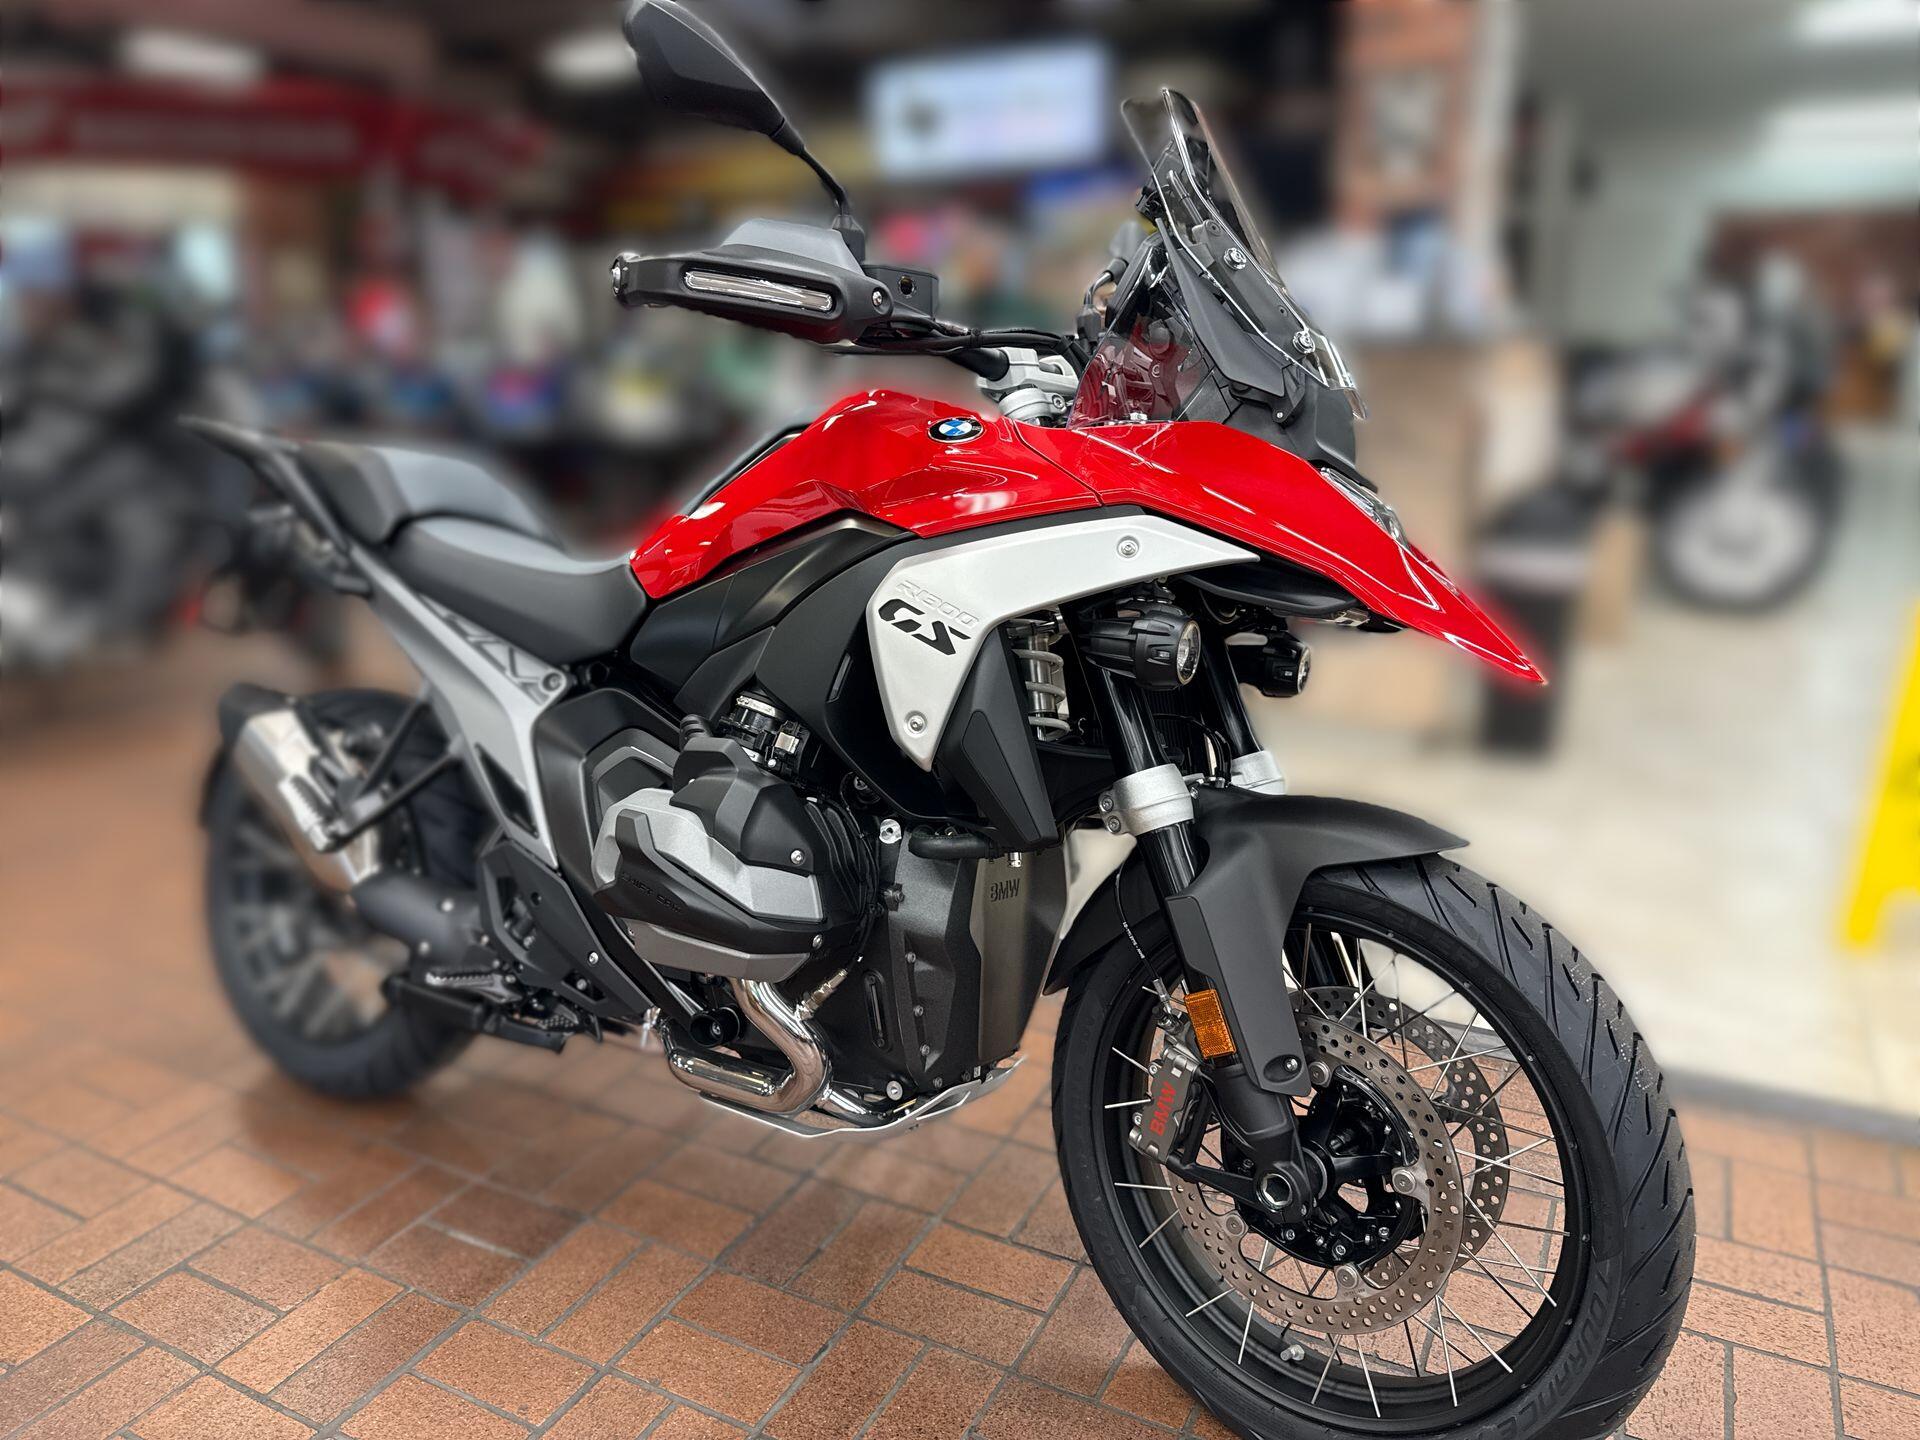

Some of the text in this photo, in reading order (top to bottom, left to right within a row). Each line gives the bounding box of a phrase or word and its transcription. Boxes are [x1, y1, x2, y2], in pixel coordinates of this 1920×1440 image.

[878, 598, 971, 655] GS
[990, 878, 1020, 902] BMW
[1149, 1080, 1177, 1137] BMW
